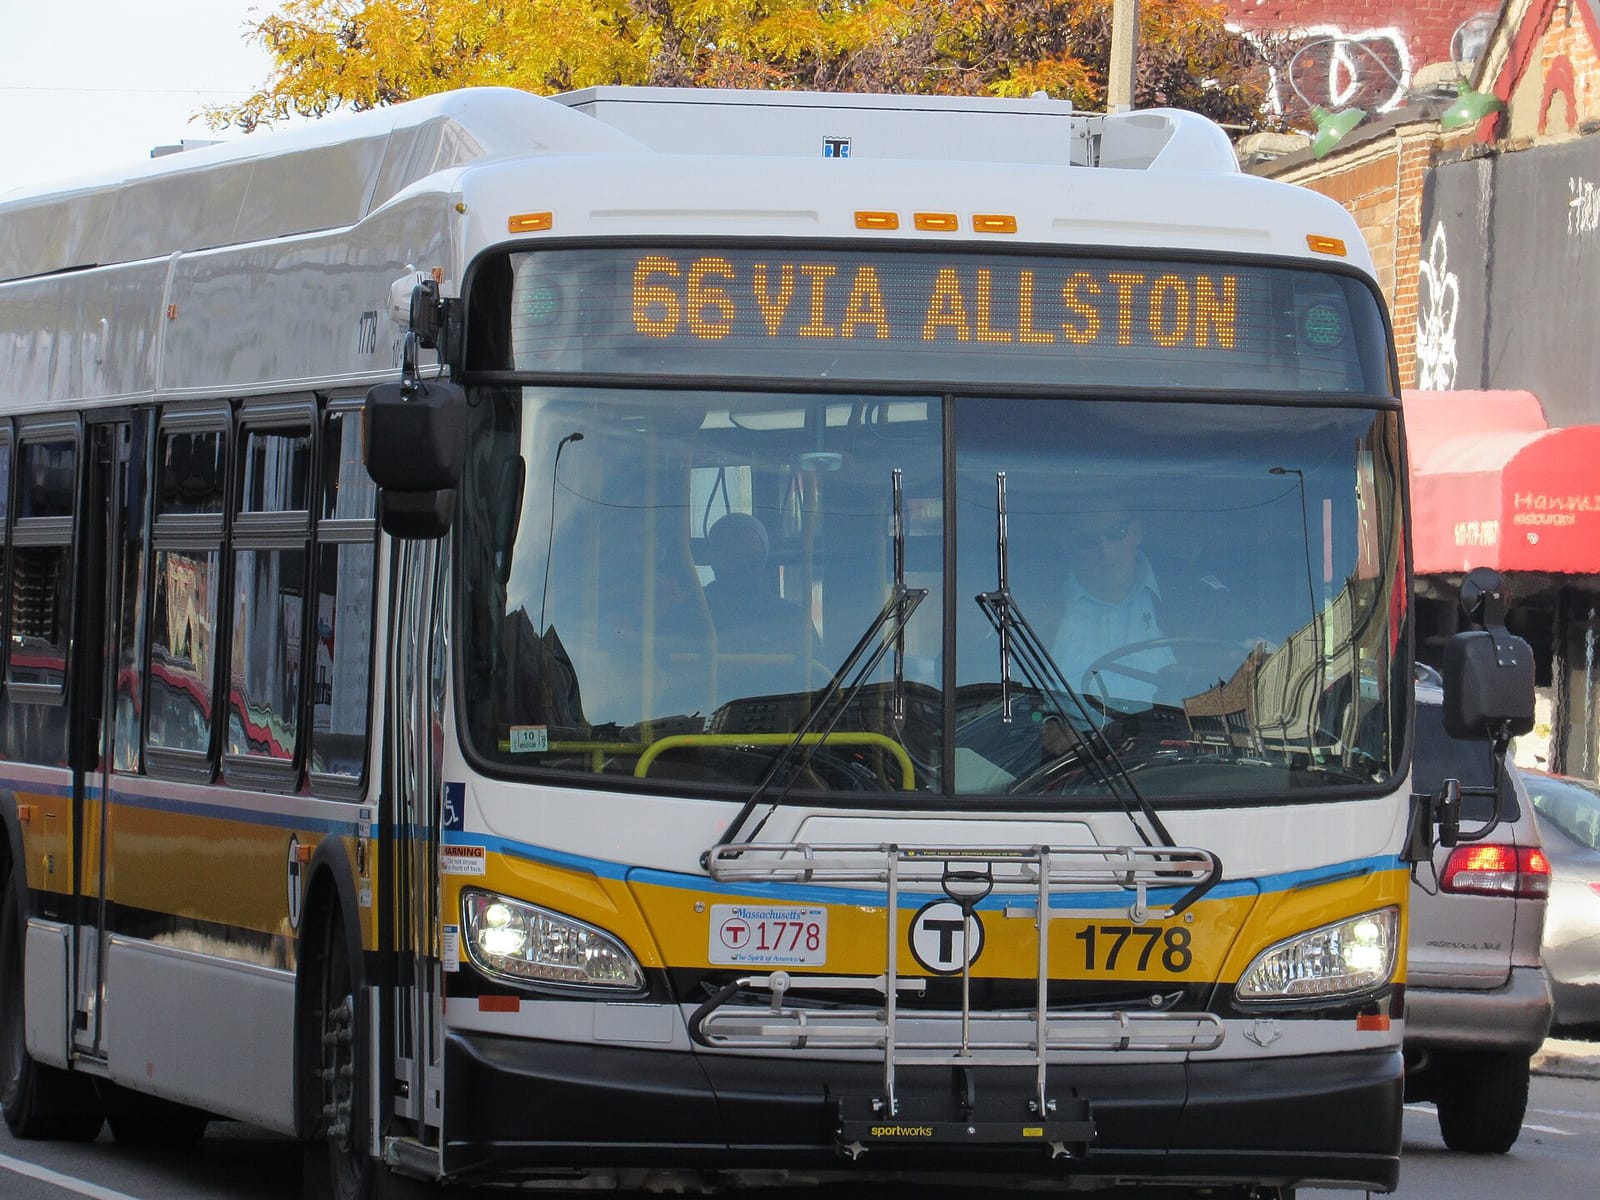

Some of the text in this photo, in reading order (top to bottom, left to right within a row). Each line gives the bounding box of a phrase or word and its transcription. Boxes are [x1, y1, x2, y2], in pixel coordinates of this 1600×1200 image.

[632, 256, 1237, 348] 66 VIA ALLSTON
[358, 311, 377, 354] 1778
[523, 732, 535, 740] 10
[737, 908, 801, 920] Massachusetts
[726, 921, 820, 951] T 1778
[923, 919, 965, 963] T
[1075, 924, 1193, 973] 1778
[871, 1125, 933, 1137] sportworks
